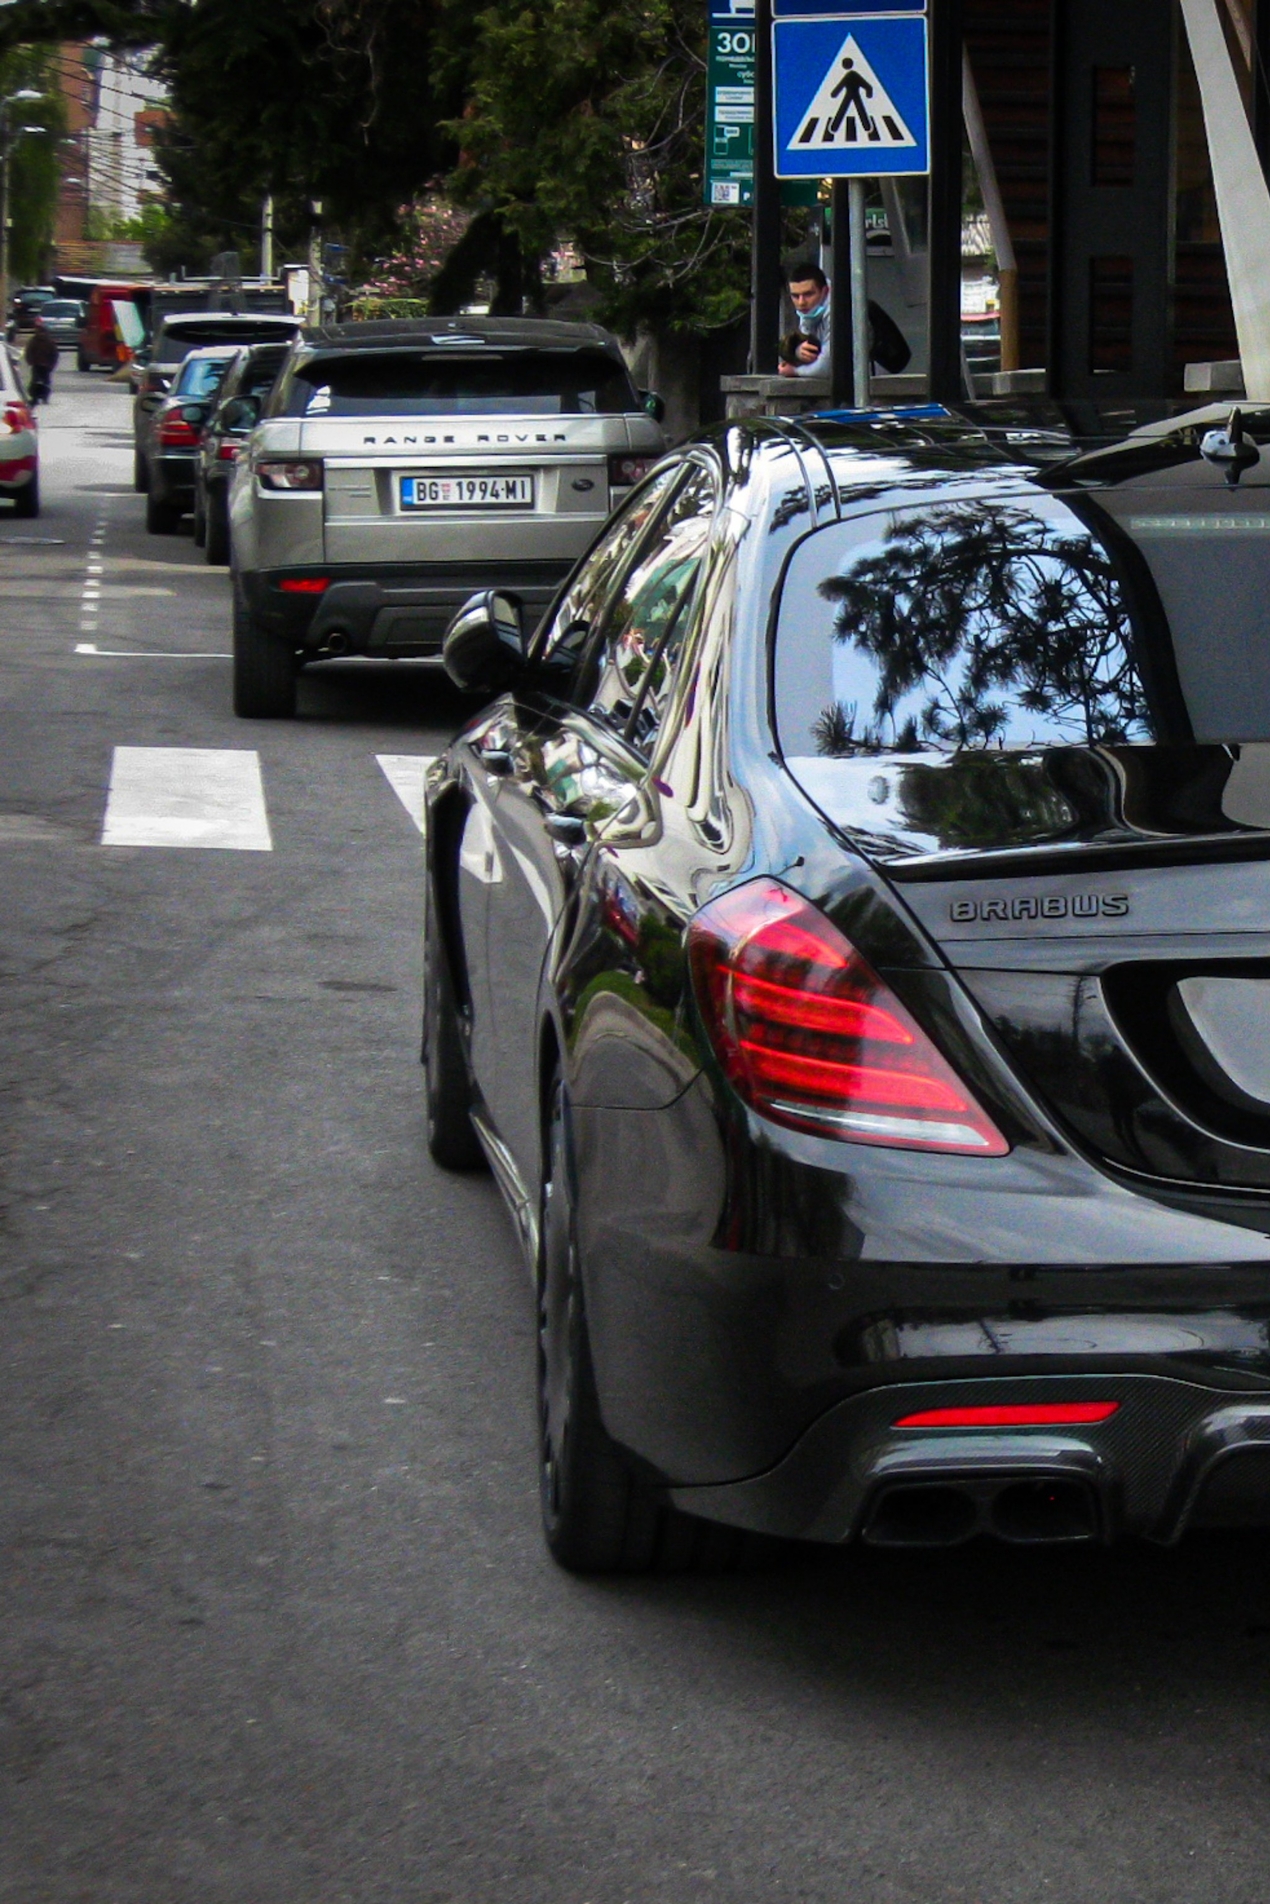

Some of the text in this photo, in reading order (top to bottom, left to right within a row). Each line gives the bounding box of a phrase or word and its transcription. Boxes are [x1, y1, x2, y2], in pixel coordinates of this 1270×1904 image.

[363, 433, 567, 444] RANGE ROVER
[416, 481, 439, 501] BG
[950, 893, 1129, 922] BRABUS
